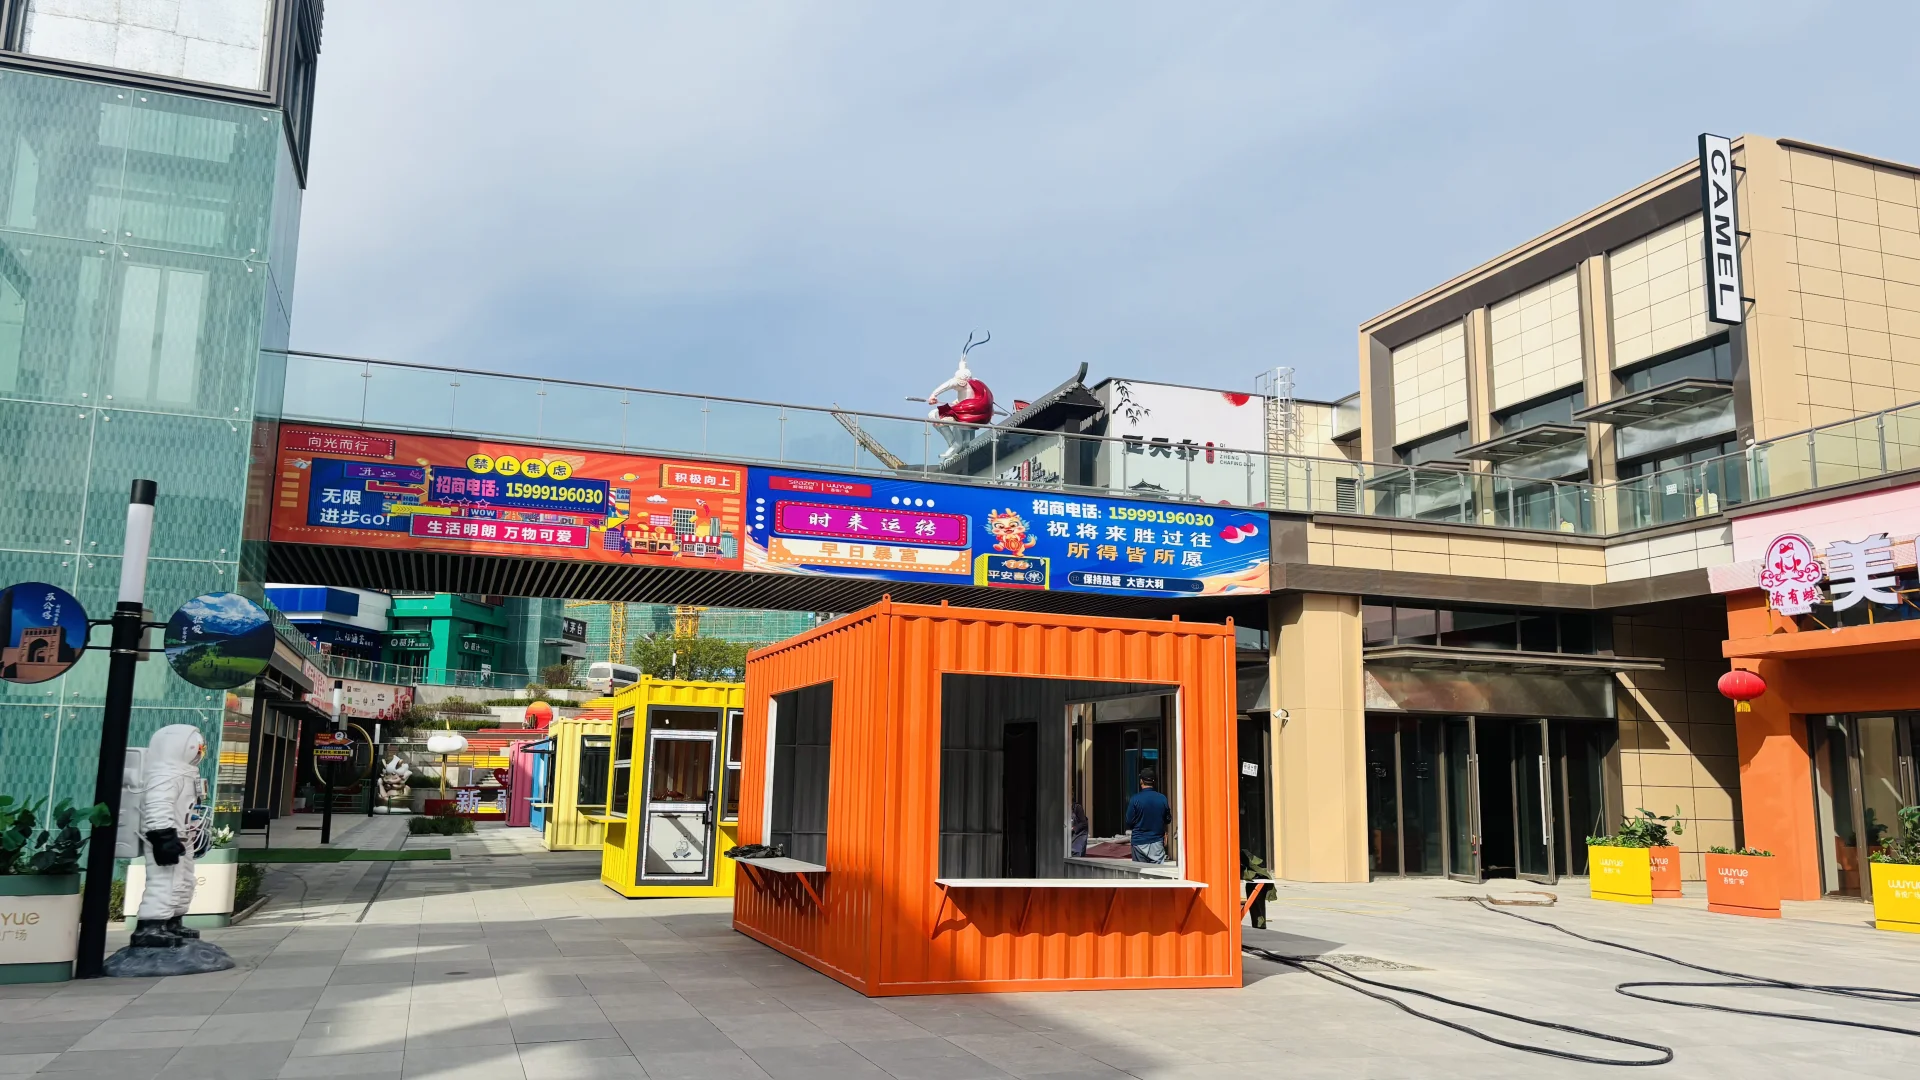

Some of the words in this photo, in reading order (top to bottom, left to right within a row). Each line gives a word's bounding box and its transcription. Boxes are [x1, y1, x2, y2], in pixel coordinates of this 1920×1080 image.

[1711, 150, 1735, 306] CAMEL
[308, 437, 369, 451] 向光而行
[473, 457, 567, 476] 禁止焦虑
[674, 472, 731, 487] 积极向上
[322, 488, 362, 505] 无限
[505, 482, 603, 504] 15999196030
[320, 508, 391, 526] 进步GO!
[471, 508, 496, 517] WOW
[1108, 506, 1215, 527] 15999196030
[427, 520, 497, 538] 生活明朗
[503, 525, 572, 543] 万物可爱
[808, 512, 938, 536] 时来运转
[1046, 520, 1212, 548] 祝将来胜过往
[819, 542, 919, 563] 早日暴富
[1067, 542, 1203, 567] 所得皆所愿
[1083, 573, 1121, 586] 保持热爱
[1126, 577, 1164, 590] 大吉大利
[1826, 532, 1920, 612] 美
[1771, 587, 1818, 607] 渝有蛙
[0, 929, 28, 941] 广场
